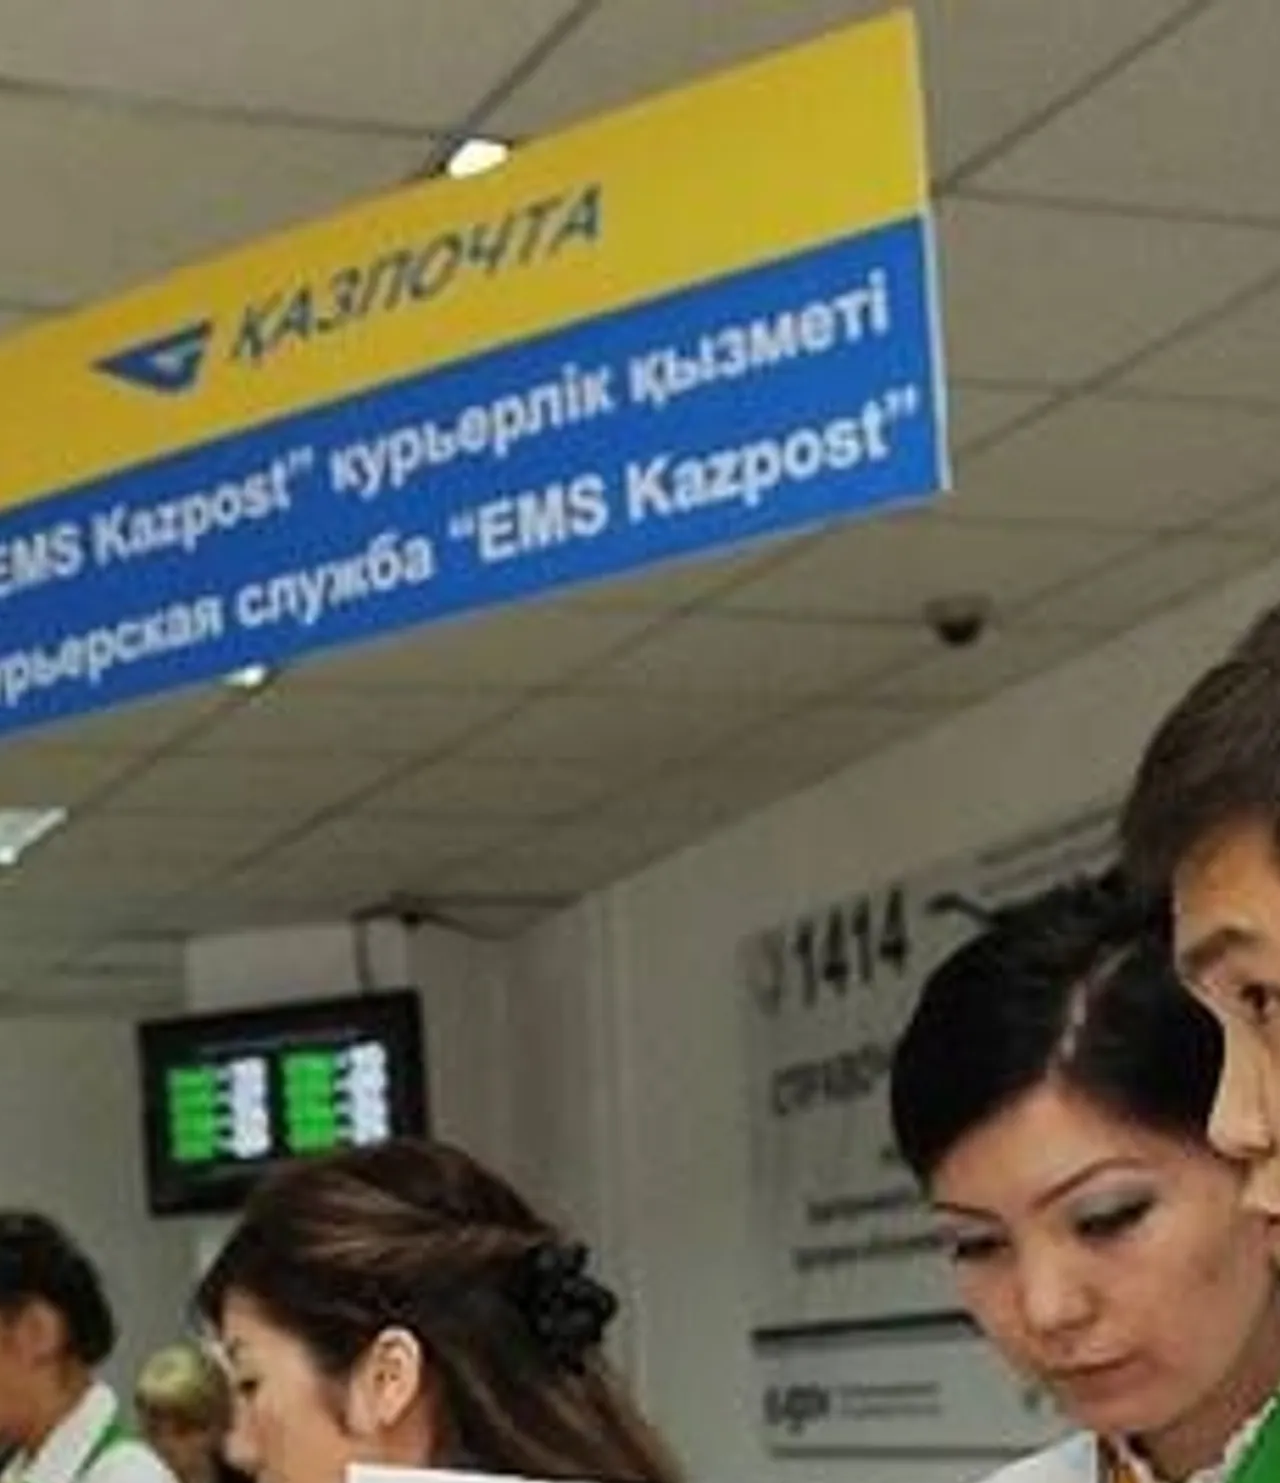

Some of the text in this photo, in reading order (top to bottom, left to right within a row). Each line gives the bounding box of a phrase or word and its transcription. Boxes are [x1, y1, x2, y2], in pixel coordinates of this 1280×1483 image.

[329, 362, 615, 497] курьерлік
[628, 268, 890, 409] қызметі
[237, 530, 435, 625] служба
[794, 882, 910, 1010] 1414
